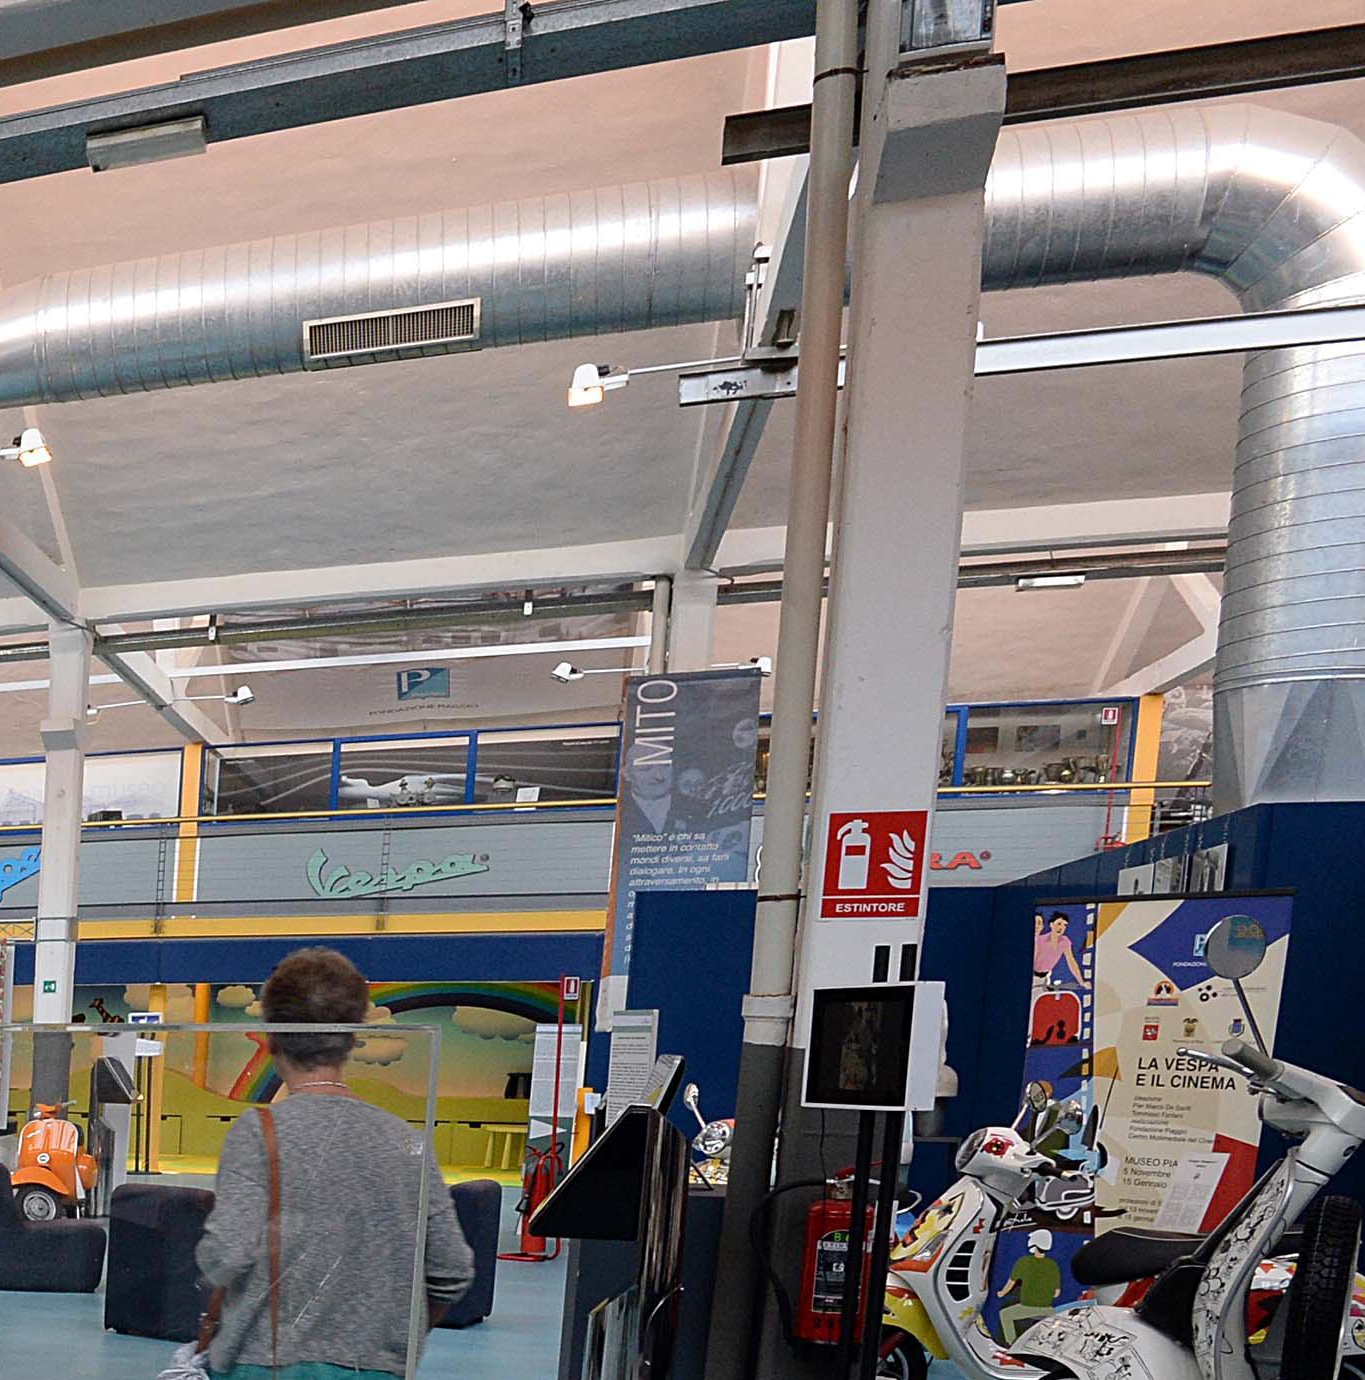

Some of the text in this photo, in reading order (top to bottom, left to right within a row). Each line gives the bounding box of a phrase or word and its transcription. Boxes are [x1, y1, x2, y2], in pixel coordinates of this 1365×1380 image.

[633, 680, 678, 766] MITO
[305, 848, 490, 899] Vespa
[835, 902, 906, 913] ESTINTORE
[1137, 1057, 1220, 1073] LA VESPA
[1135, 1073, 1237, 1091] E IL CINEMA
[1125, 1156, 1161, 1168] MUSEO
[1162, 1158, 1179, 1168] PIA
[1131, 1168, 1172, 1178] Novembre
